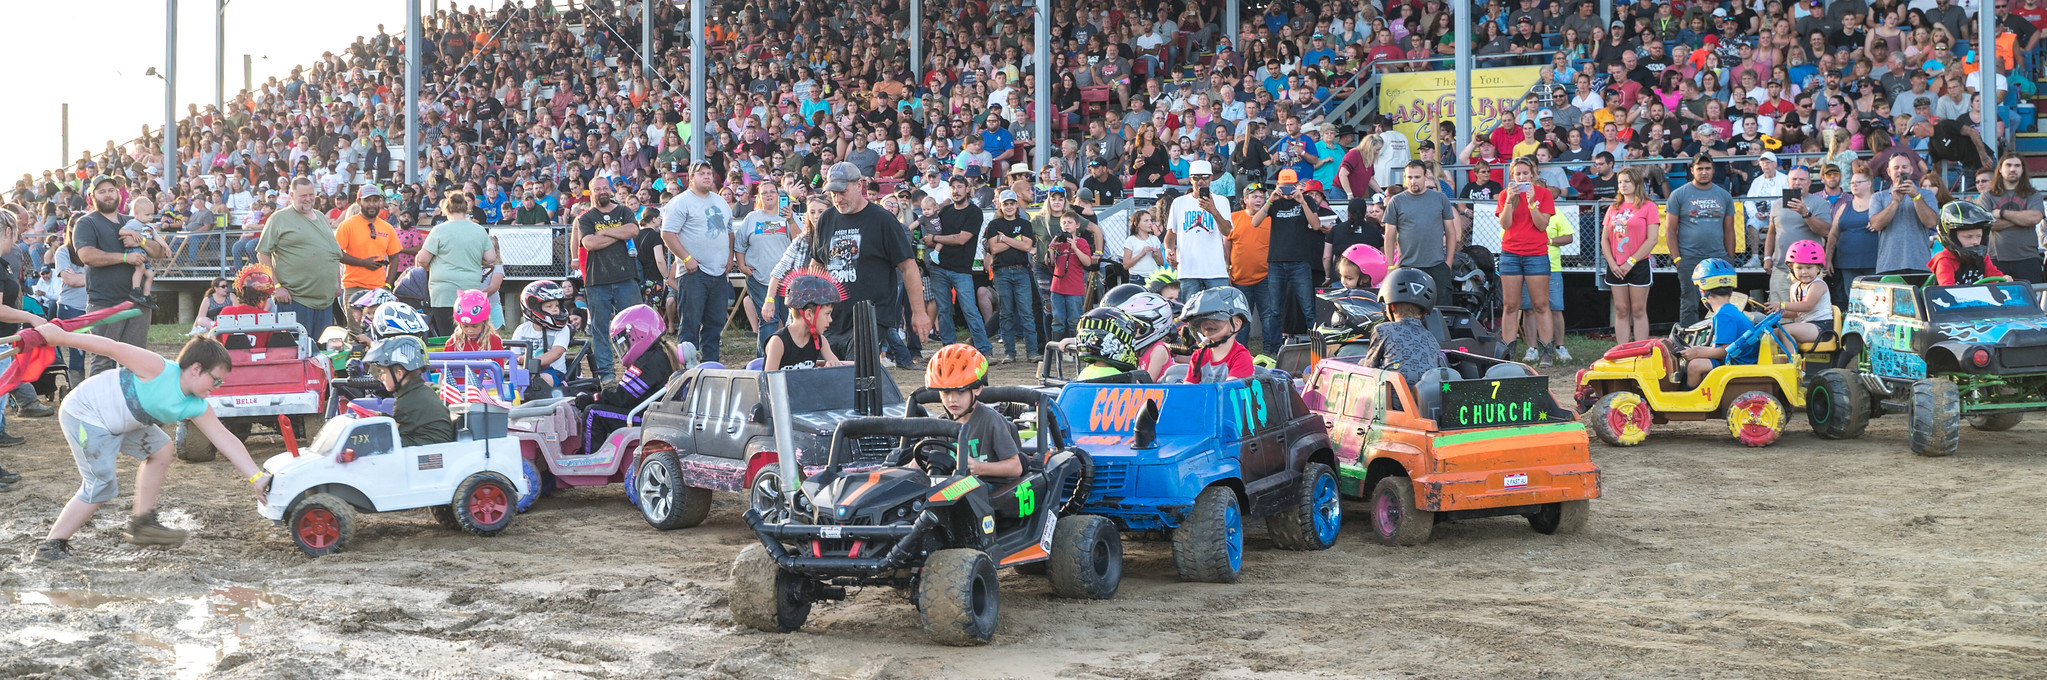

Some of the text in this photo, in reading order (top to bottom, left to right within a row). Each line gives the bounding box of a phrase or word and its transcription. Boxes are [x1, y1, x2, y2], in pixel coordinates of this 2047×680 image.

[1480, 75, 1504, 84] You.
[1391, 93, 1521, 124] ASHTBU
[1491, 381, 1500, 399] 7
[1701, 387, 1712, 401] 4
[1229, 379, 1267, 437] 173
[1460, 401, 1532, 425] CHURCH
[350, 434, 370, 445] 73X
[1015, 480, 1035, 518] 15
